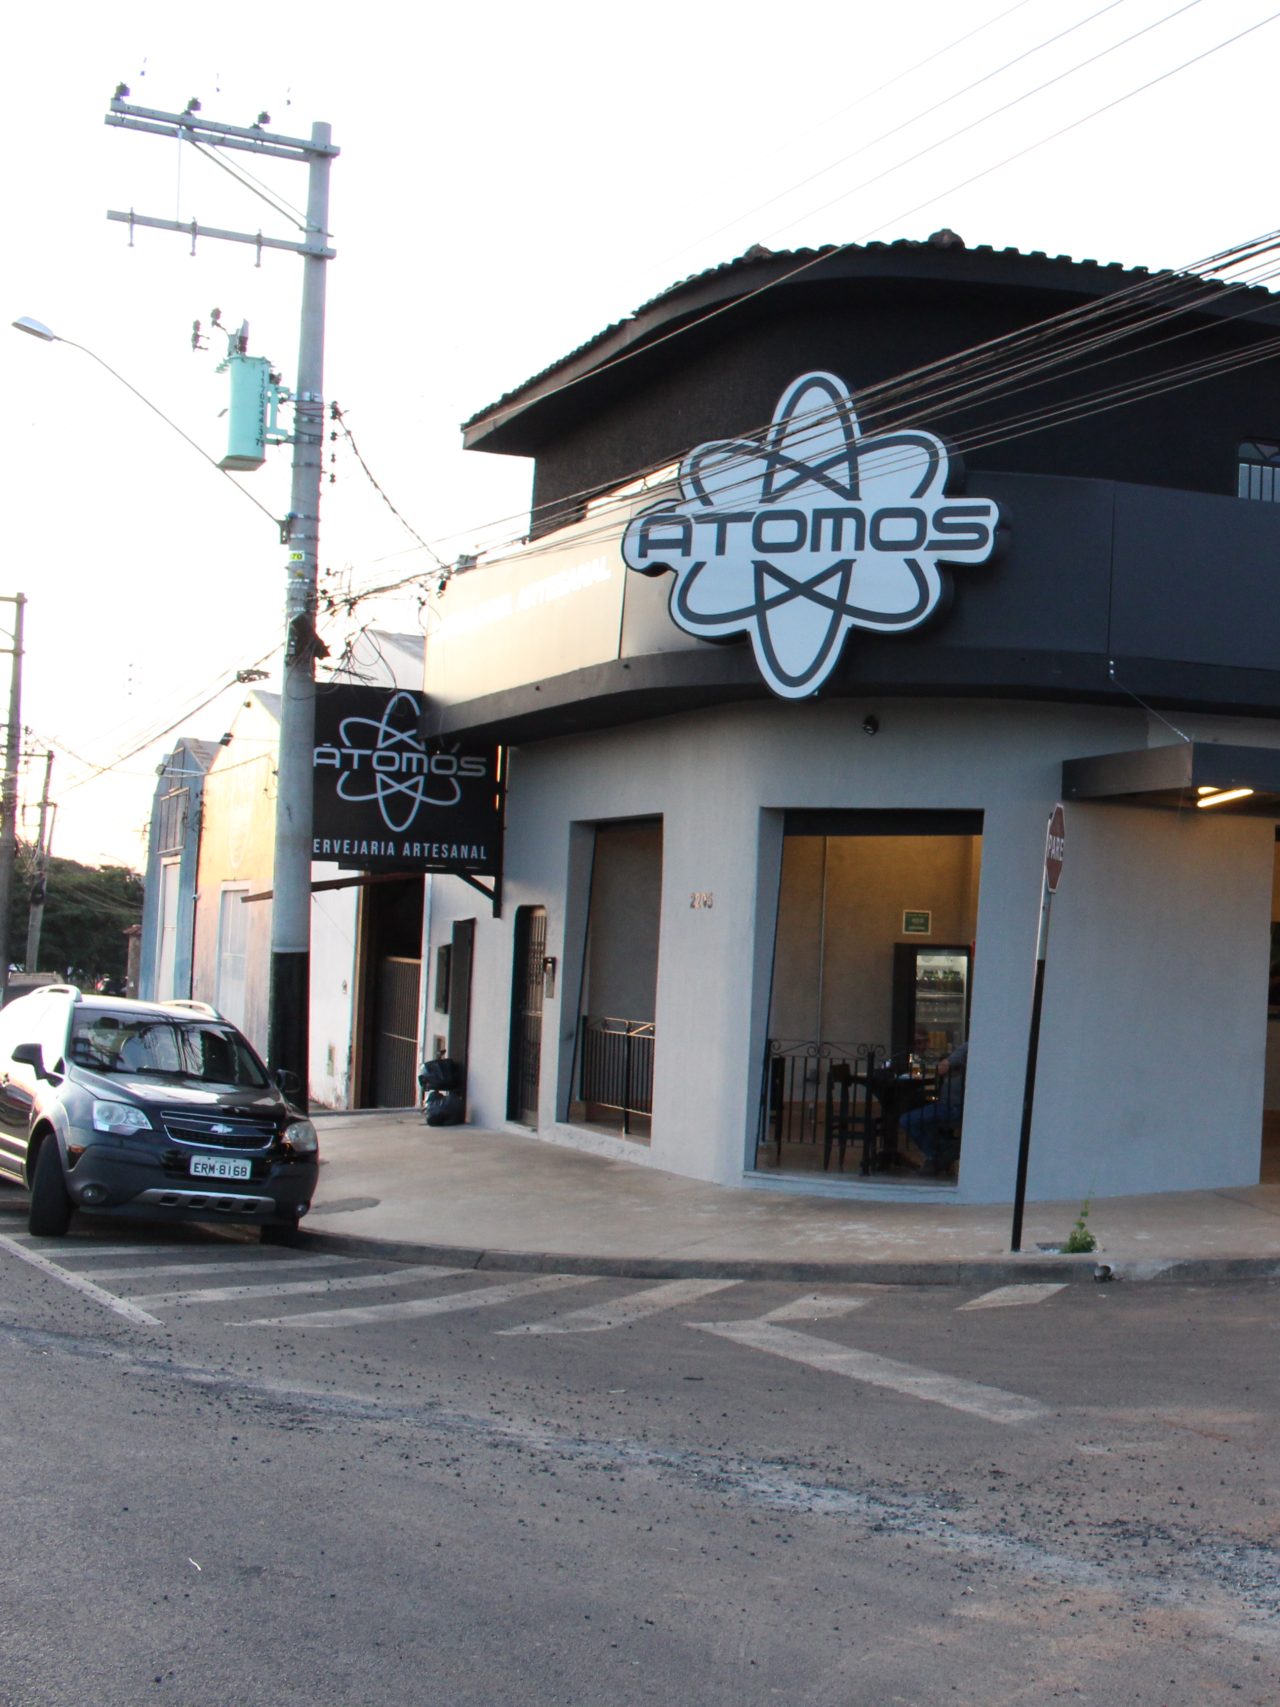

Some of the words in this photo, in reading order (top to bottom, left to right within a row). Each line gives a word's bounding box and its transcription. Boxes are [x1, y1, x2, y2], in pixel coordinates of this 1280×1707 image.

[313, 838, 395, 856] ERVEJARIA
[403, 842, 488, 860] ARTESANAL
[1046, 833, 1065, 862] PARE
